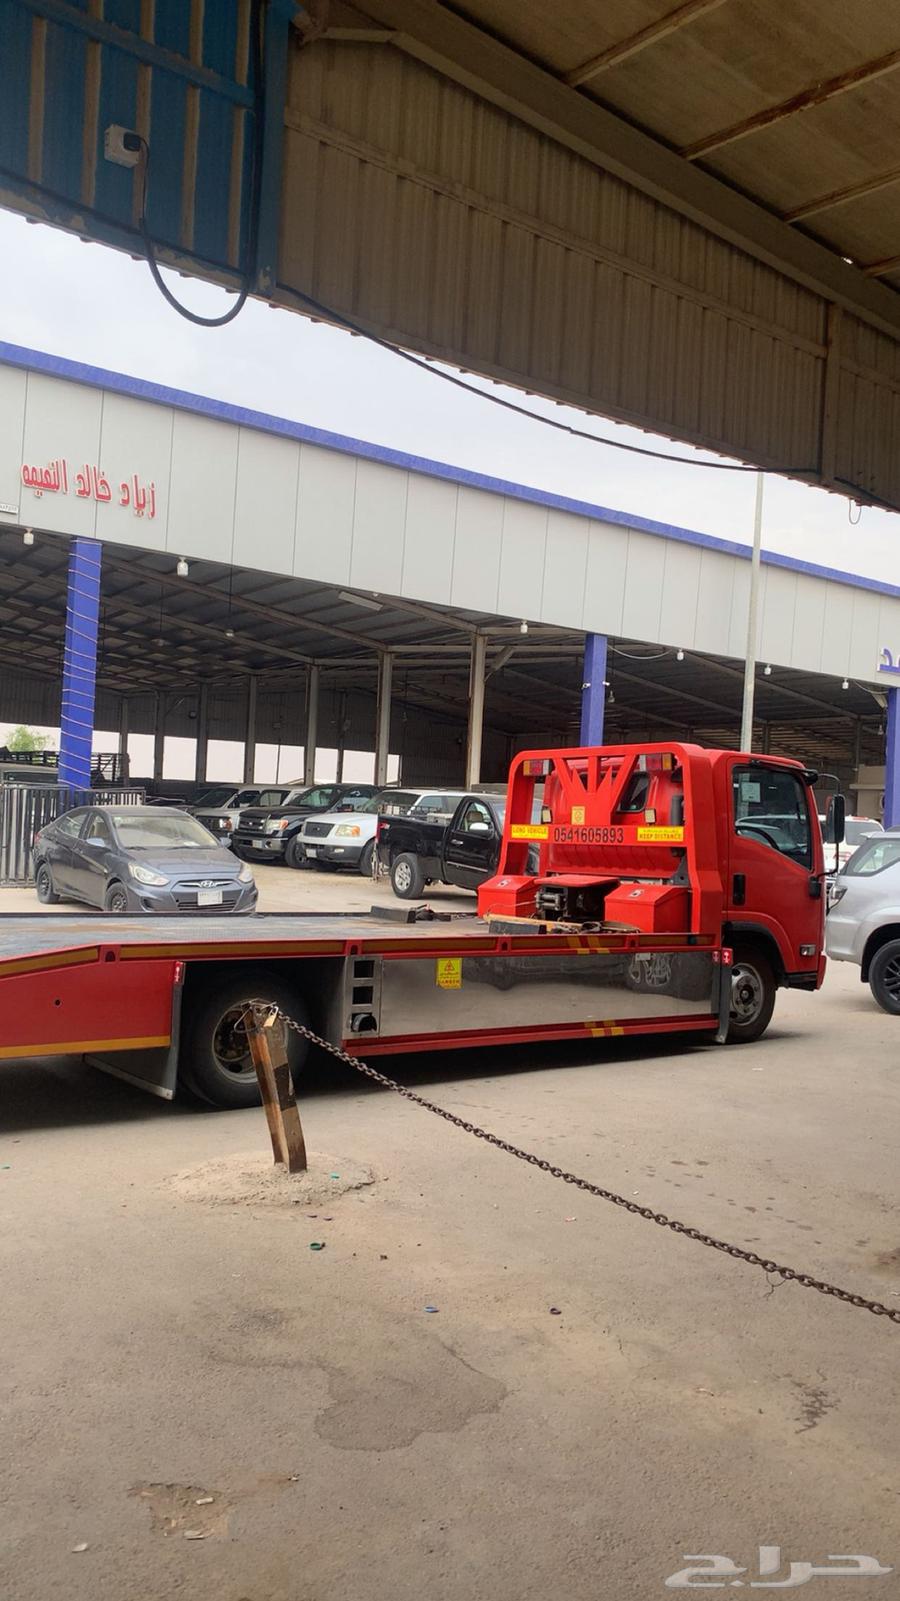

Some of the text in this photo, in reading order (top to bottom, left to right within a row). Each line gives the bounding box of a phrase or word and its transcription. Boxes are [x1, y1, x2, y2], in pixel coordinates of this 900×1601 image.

[75, 463, 112, 502] خالد
[119, 473, 156, 519] زياد
[554, 827, 624, 844] 0541605893
